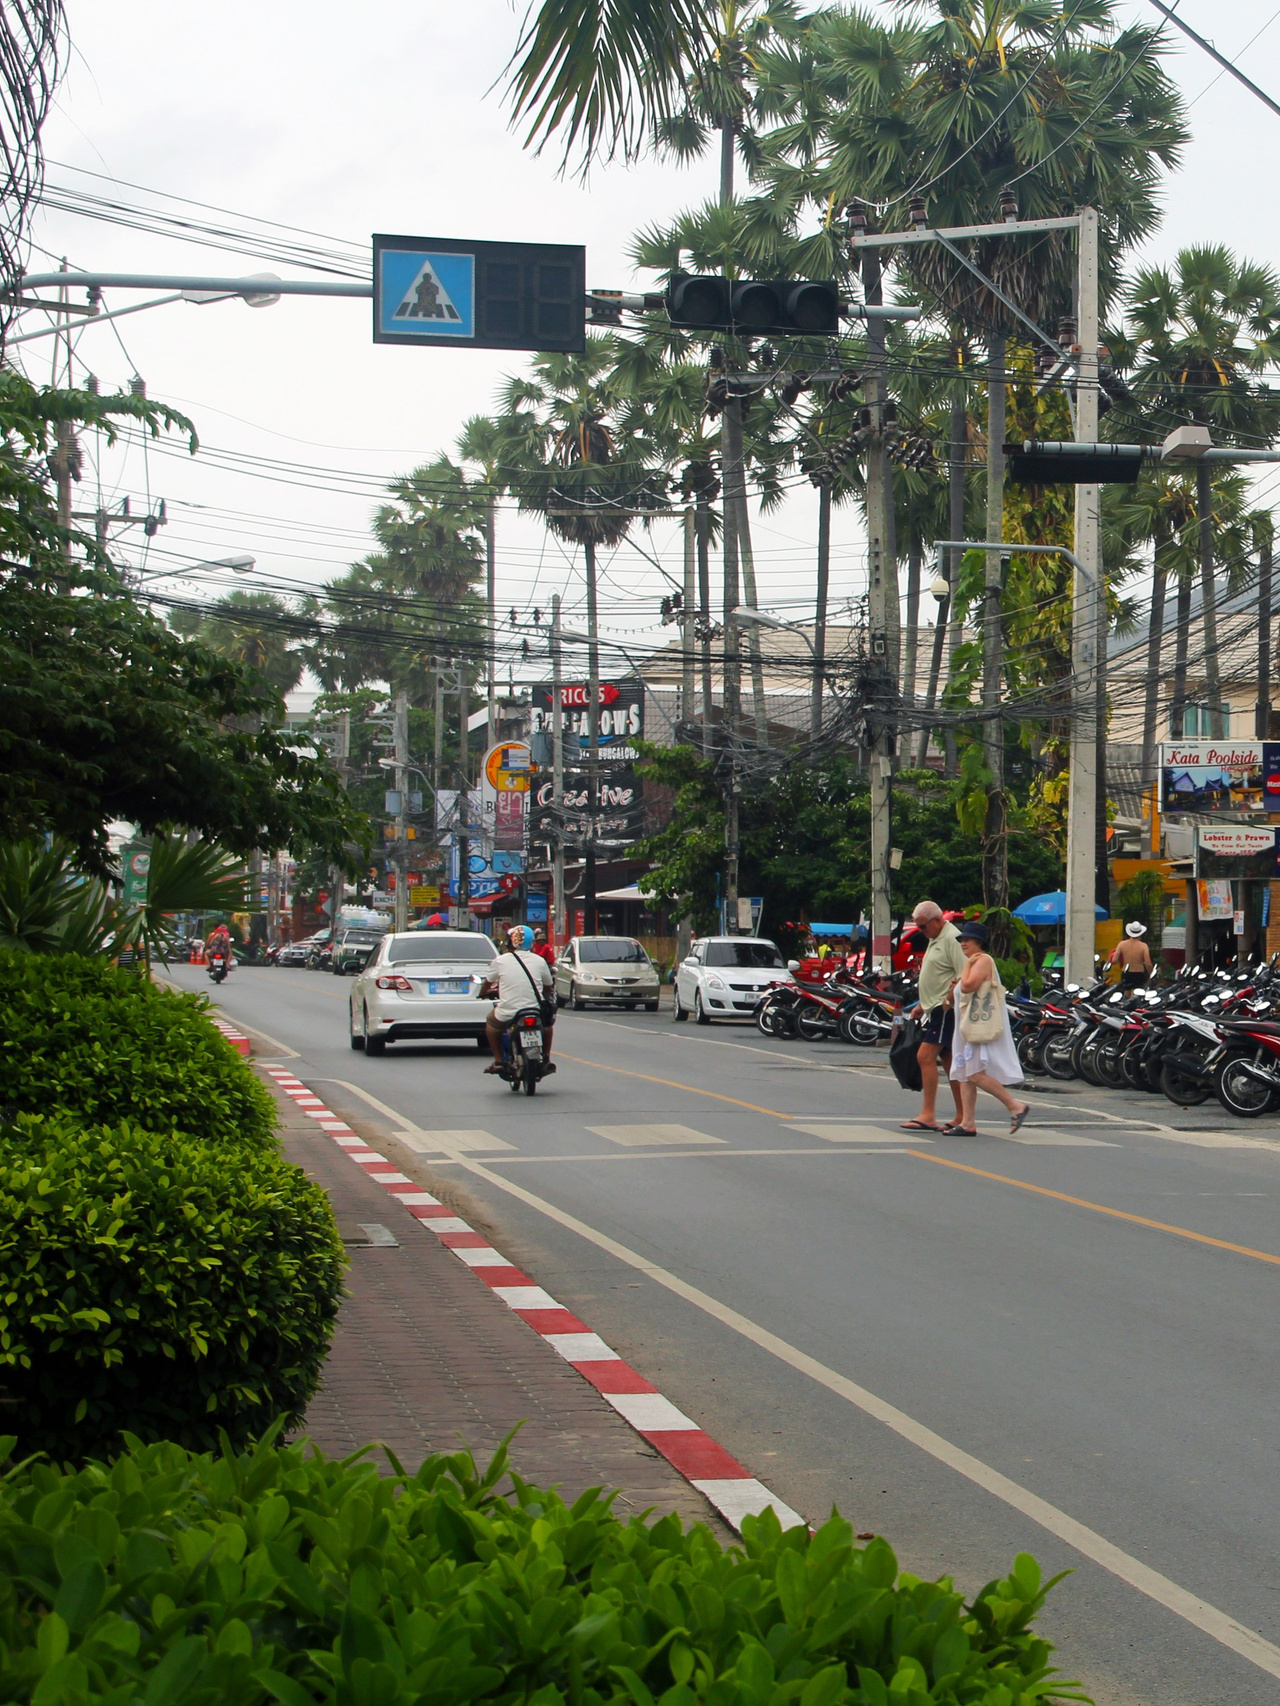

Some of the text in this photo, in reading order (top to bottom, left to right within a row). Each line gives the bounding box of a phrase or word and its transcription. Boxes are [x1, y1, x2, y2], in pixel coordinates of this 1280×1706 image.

[1166, 748, 1259, 765] Kata Poolside
[1203, 834, 1233, 842] Lobster
[1245, 834, 1271, 842] Prawn
